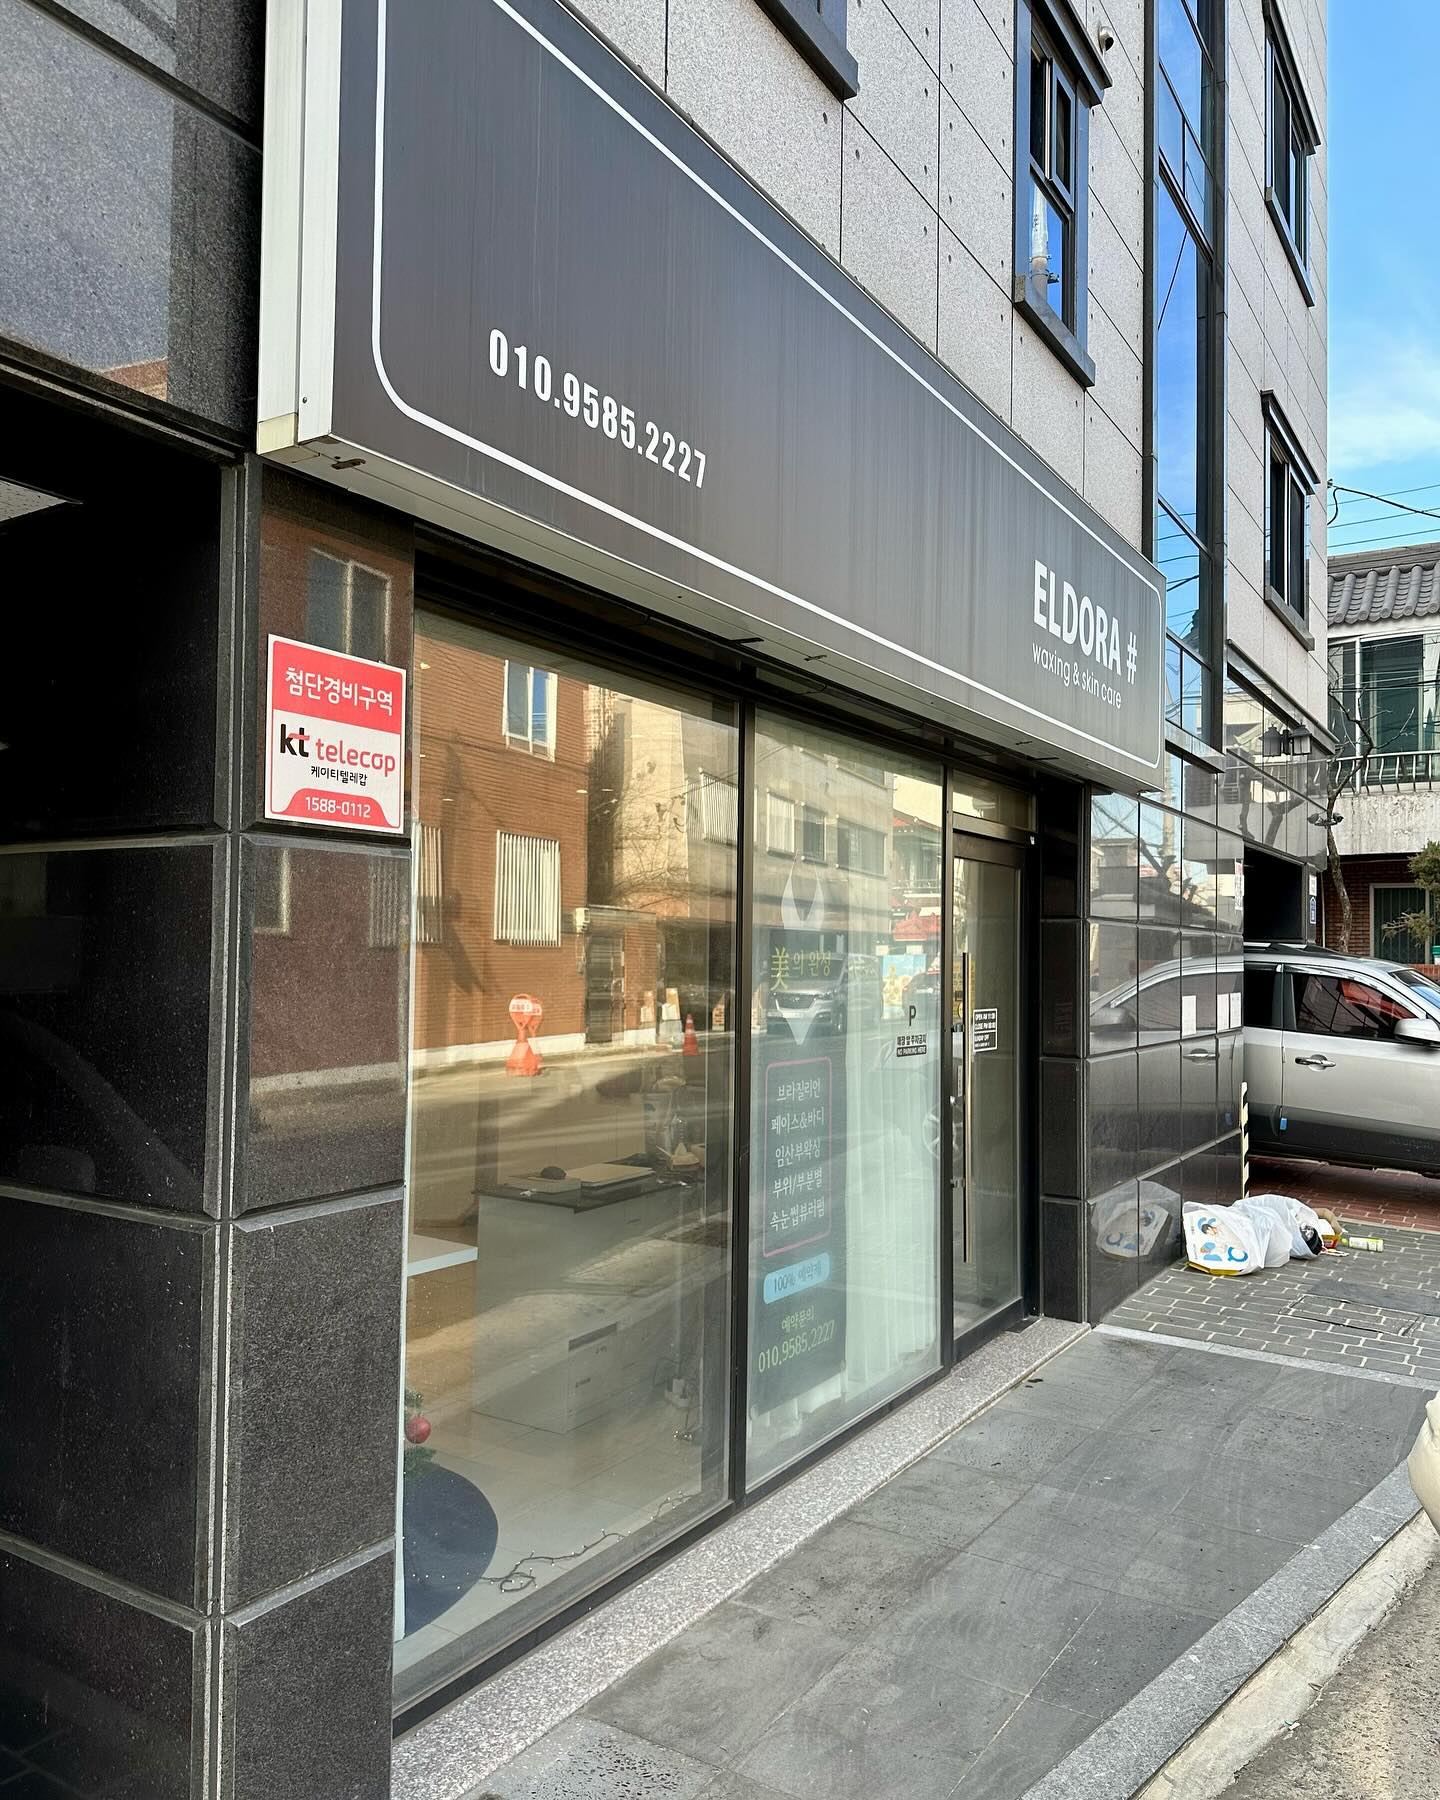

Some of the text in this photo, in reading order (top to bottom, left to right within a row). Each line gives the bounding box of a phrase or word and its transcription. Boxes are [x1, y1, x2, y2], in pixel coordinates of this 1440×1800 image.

[489, 328, 706, 489] 010.9585.2227
[1034, 559, 1122, 676] ELDORA
[285, 667, 393, 716] 첨단경비구역
[1032, 642, 1122, 709] waxing & skin care
[280, 723, 396, 777] kt telecop
[310, 765, 368, 787] 케이티텔레캅
[305, 796, 371, 818] 1588-0112
[776, 1077, 821, 1101] 브라질리언
[771, 1106, 824, 1136] 페이스&바디
[775, 1136, 820, 1168] 임산부왁싱
[773, 1167, 822, 1199] 부위/부분별
[781, 1305, 817, 1333] 예약문의
[758, 1319, 835, 1373] 010.9585.2227
